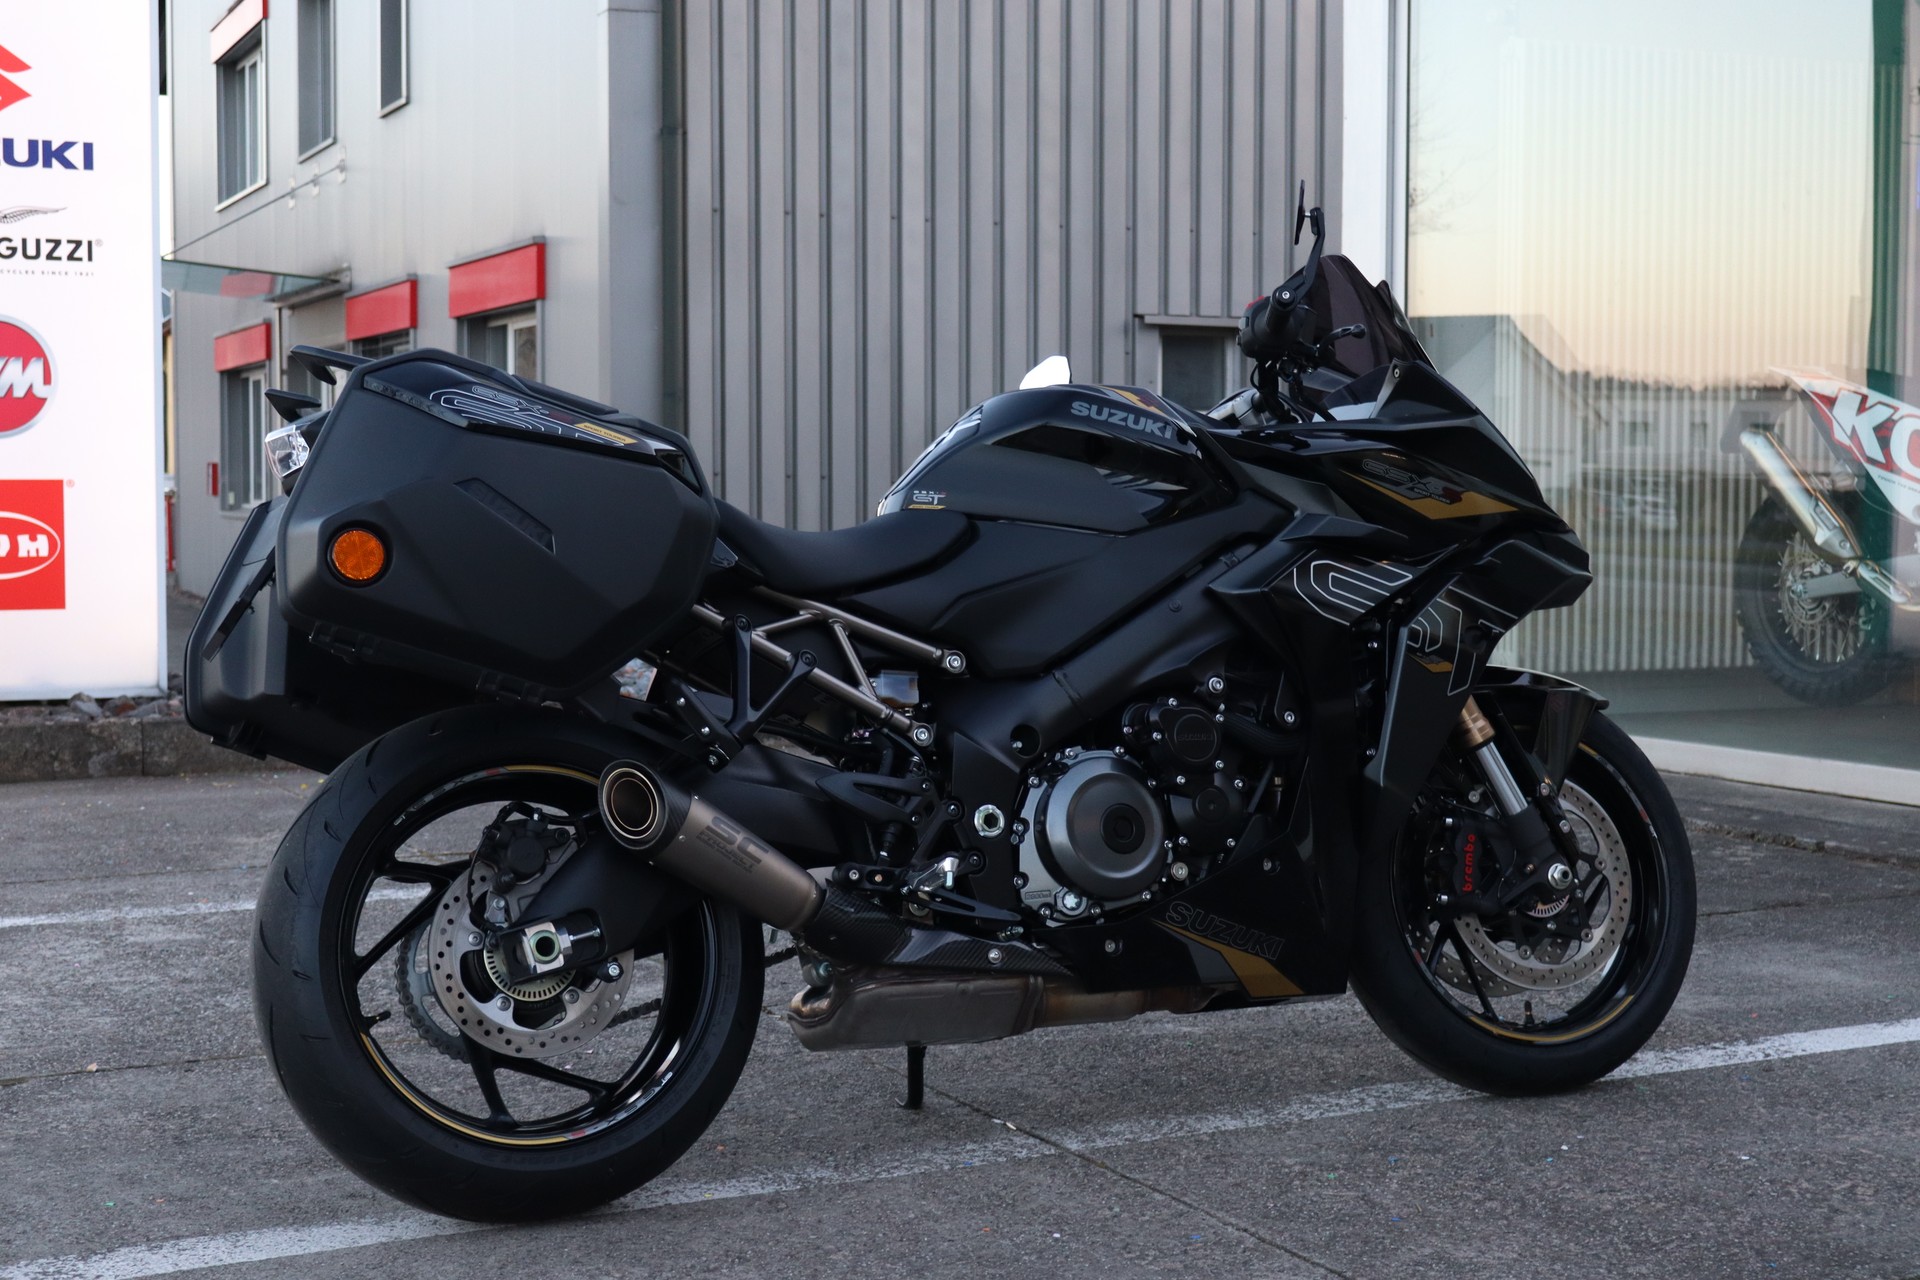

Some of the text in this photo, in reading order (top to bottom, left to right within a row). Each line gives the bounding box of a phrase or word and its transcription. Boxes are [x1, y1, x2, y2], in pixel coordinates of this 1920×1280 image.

[0, 138, 94, 171] UKI
[1070, 401, 1172, 439] SUZUKI
[705, 815, 770, 865] SC
[1462, 834, 1476, 892] brembo
[1166, 901, 1285, 960] SUZUKI
